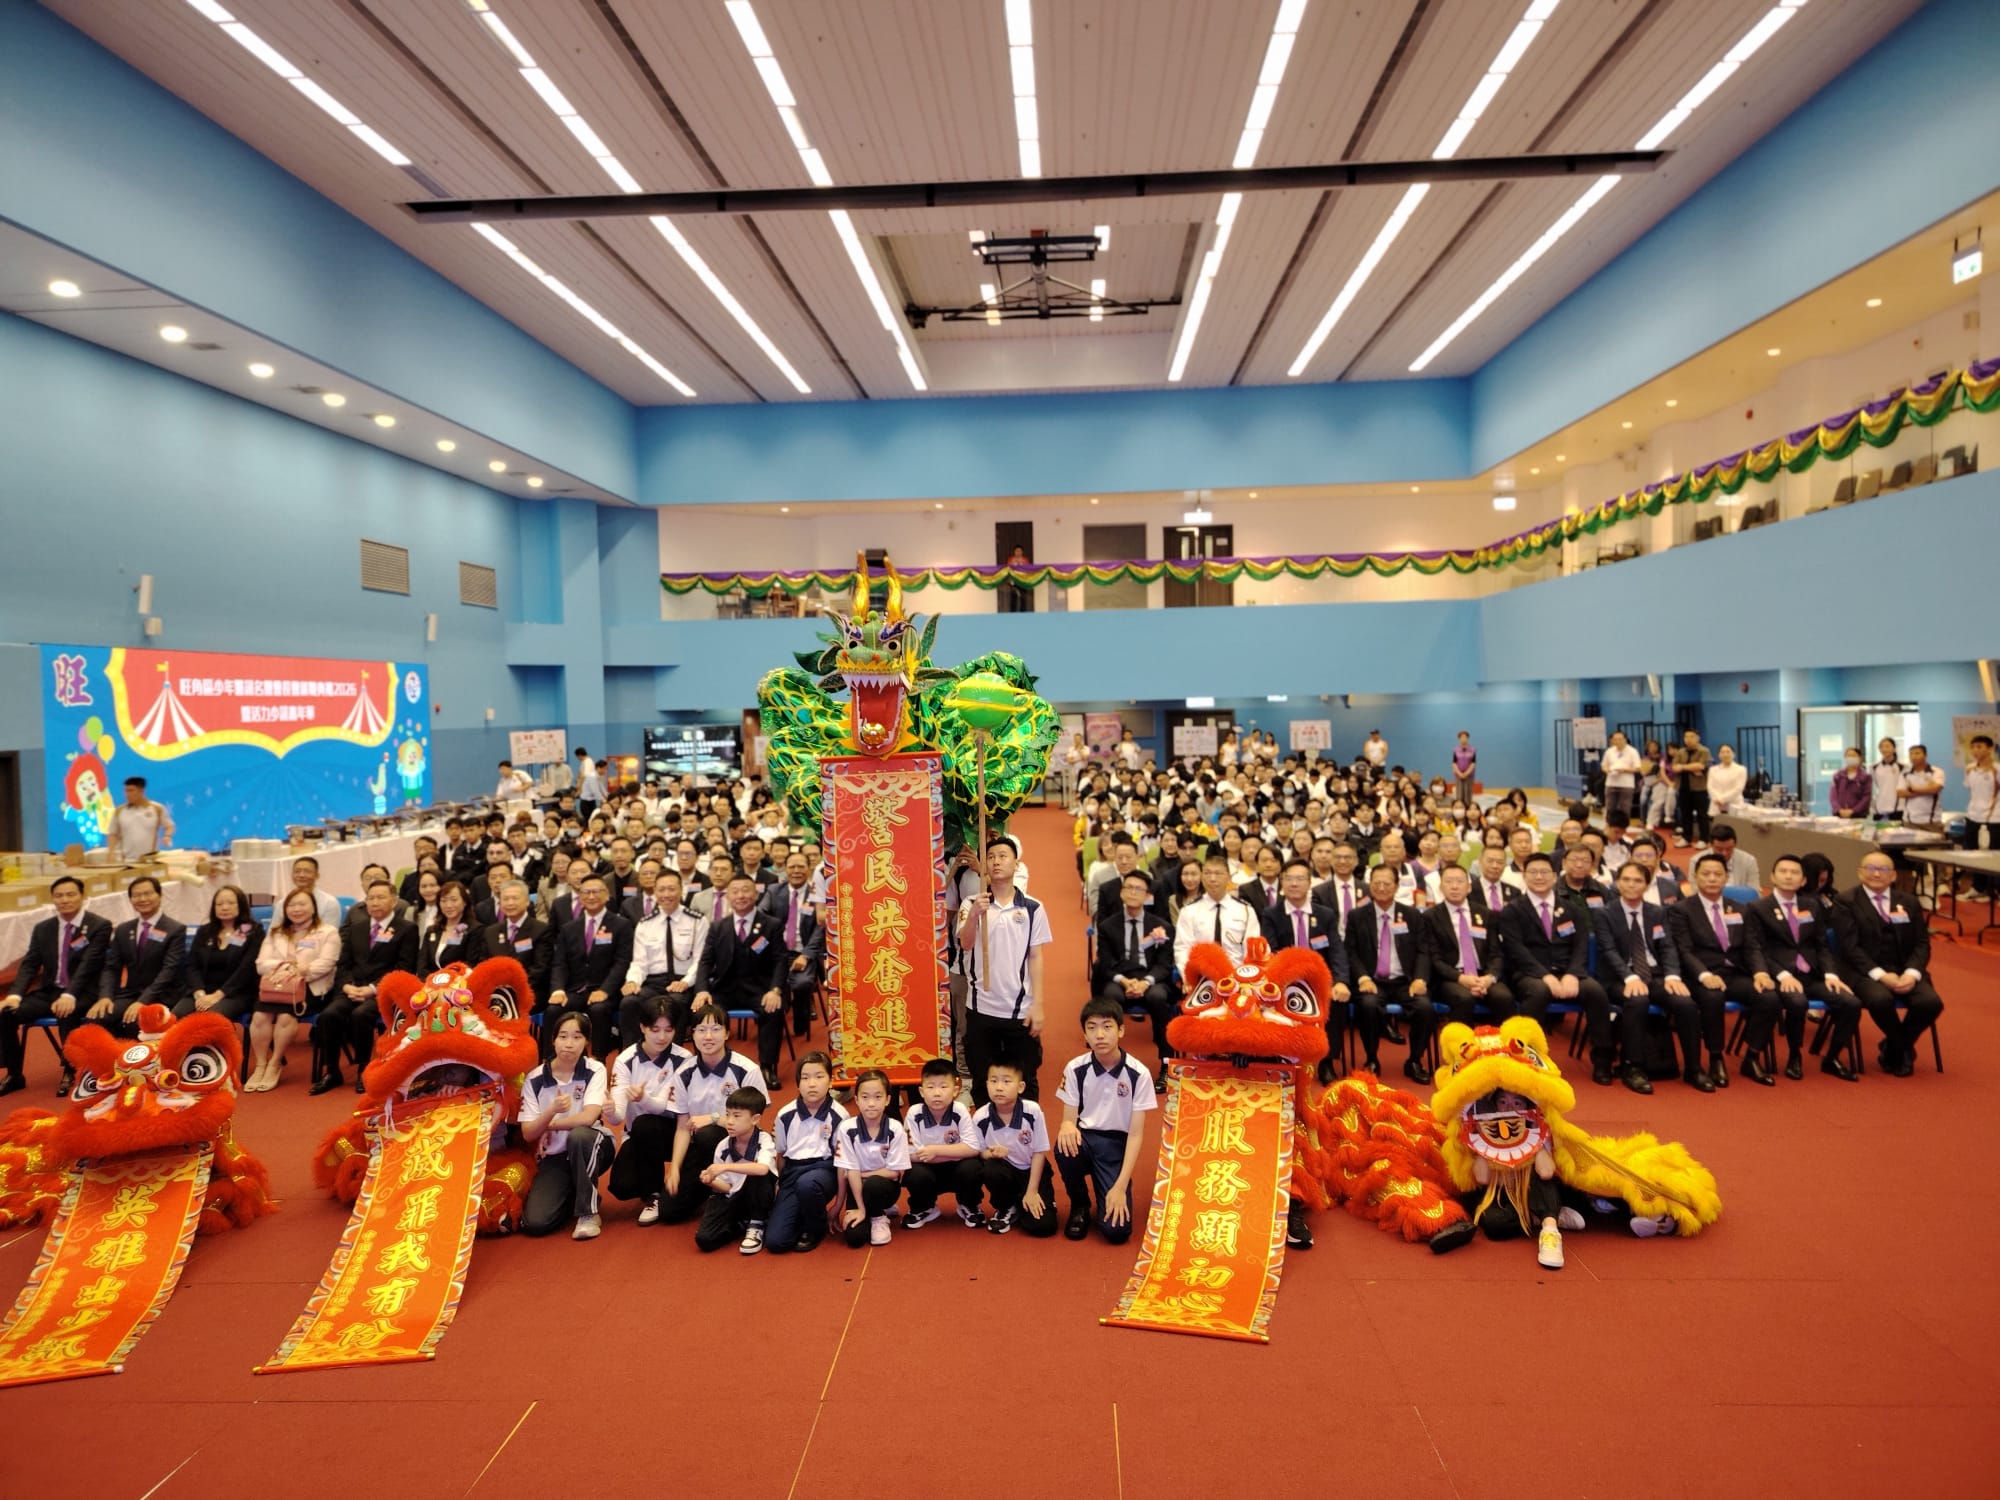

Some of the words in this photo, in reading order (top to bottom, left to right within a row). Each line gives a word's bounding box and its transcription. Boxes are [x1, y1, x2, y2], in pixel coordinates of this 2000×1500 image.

[862, 797, 917, 1044] 警民共奮進
[336, 1136, 453, 1347] 滅罪我有份
[1165, 1108, 1255, 1313] 服務顯初心
